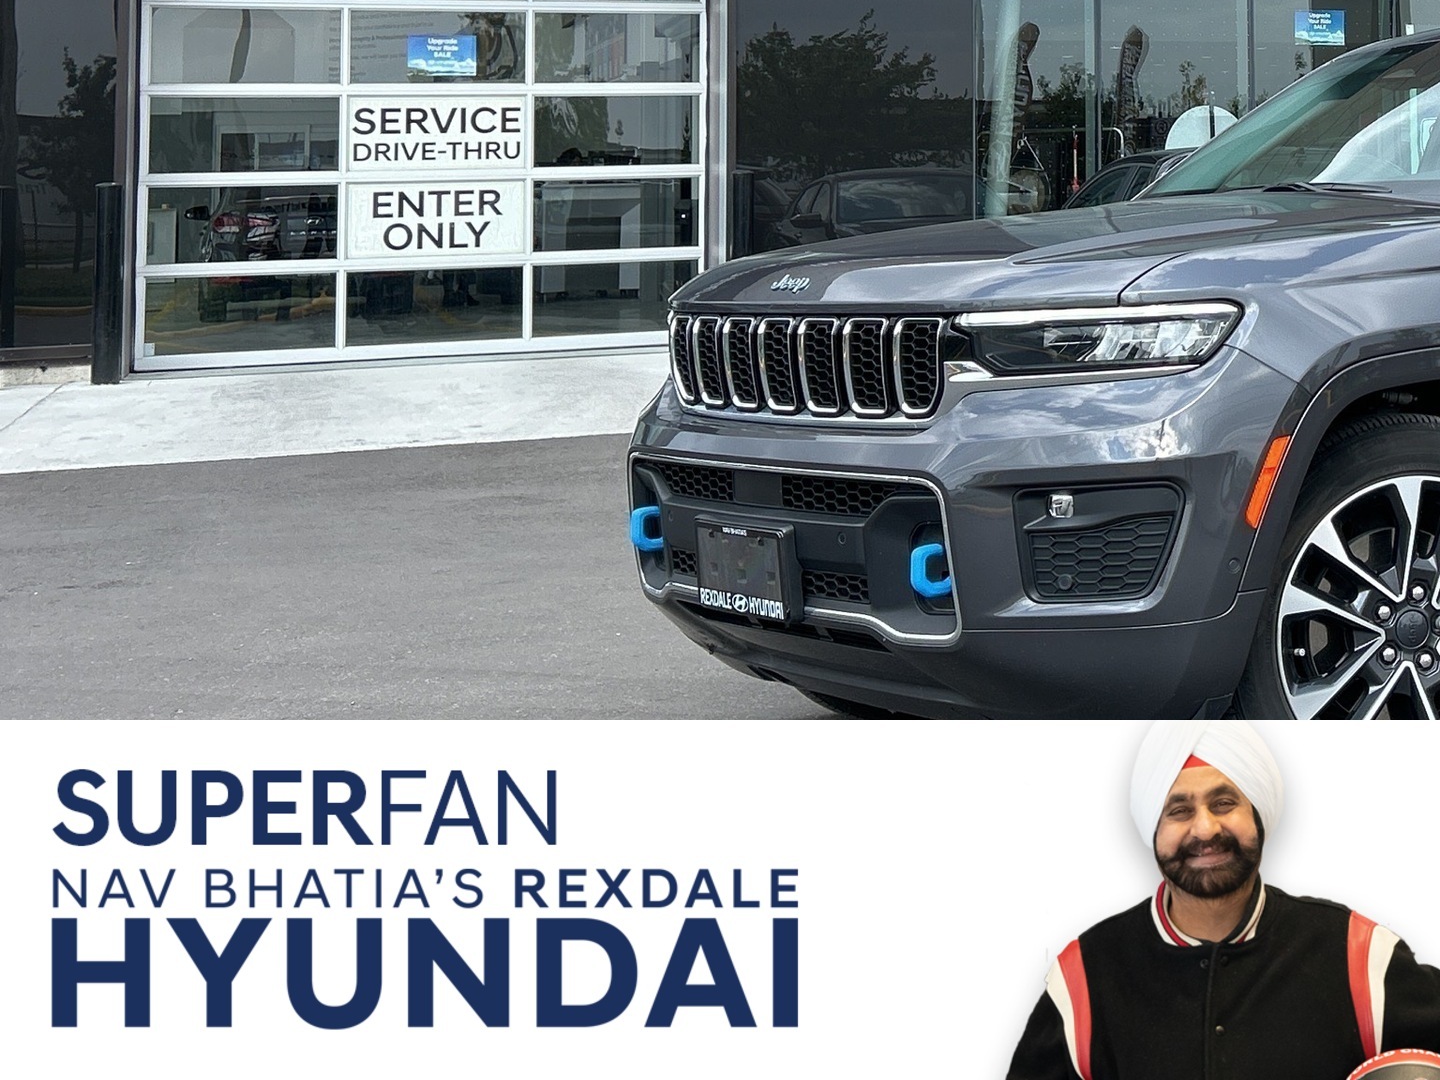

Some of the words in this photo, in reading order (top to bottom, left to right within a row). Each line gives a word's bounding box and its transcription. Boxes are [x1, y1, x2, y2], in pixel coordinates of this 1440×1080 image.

[427, 38, 458, 46] Upgrade
[352, 107, 521, 135] SERVICE
[353, 141, 521, 162] DRIVE-THRU
[372, 189, 503, 219] ENTER
[383, 221, 491, 251] ONLY
[770, 274, 810, 293] Jeep
[700, 587, 733, 610] REXDALE
[748, 596, 785, 620] HYUNDAI
